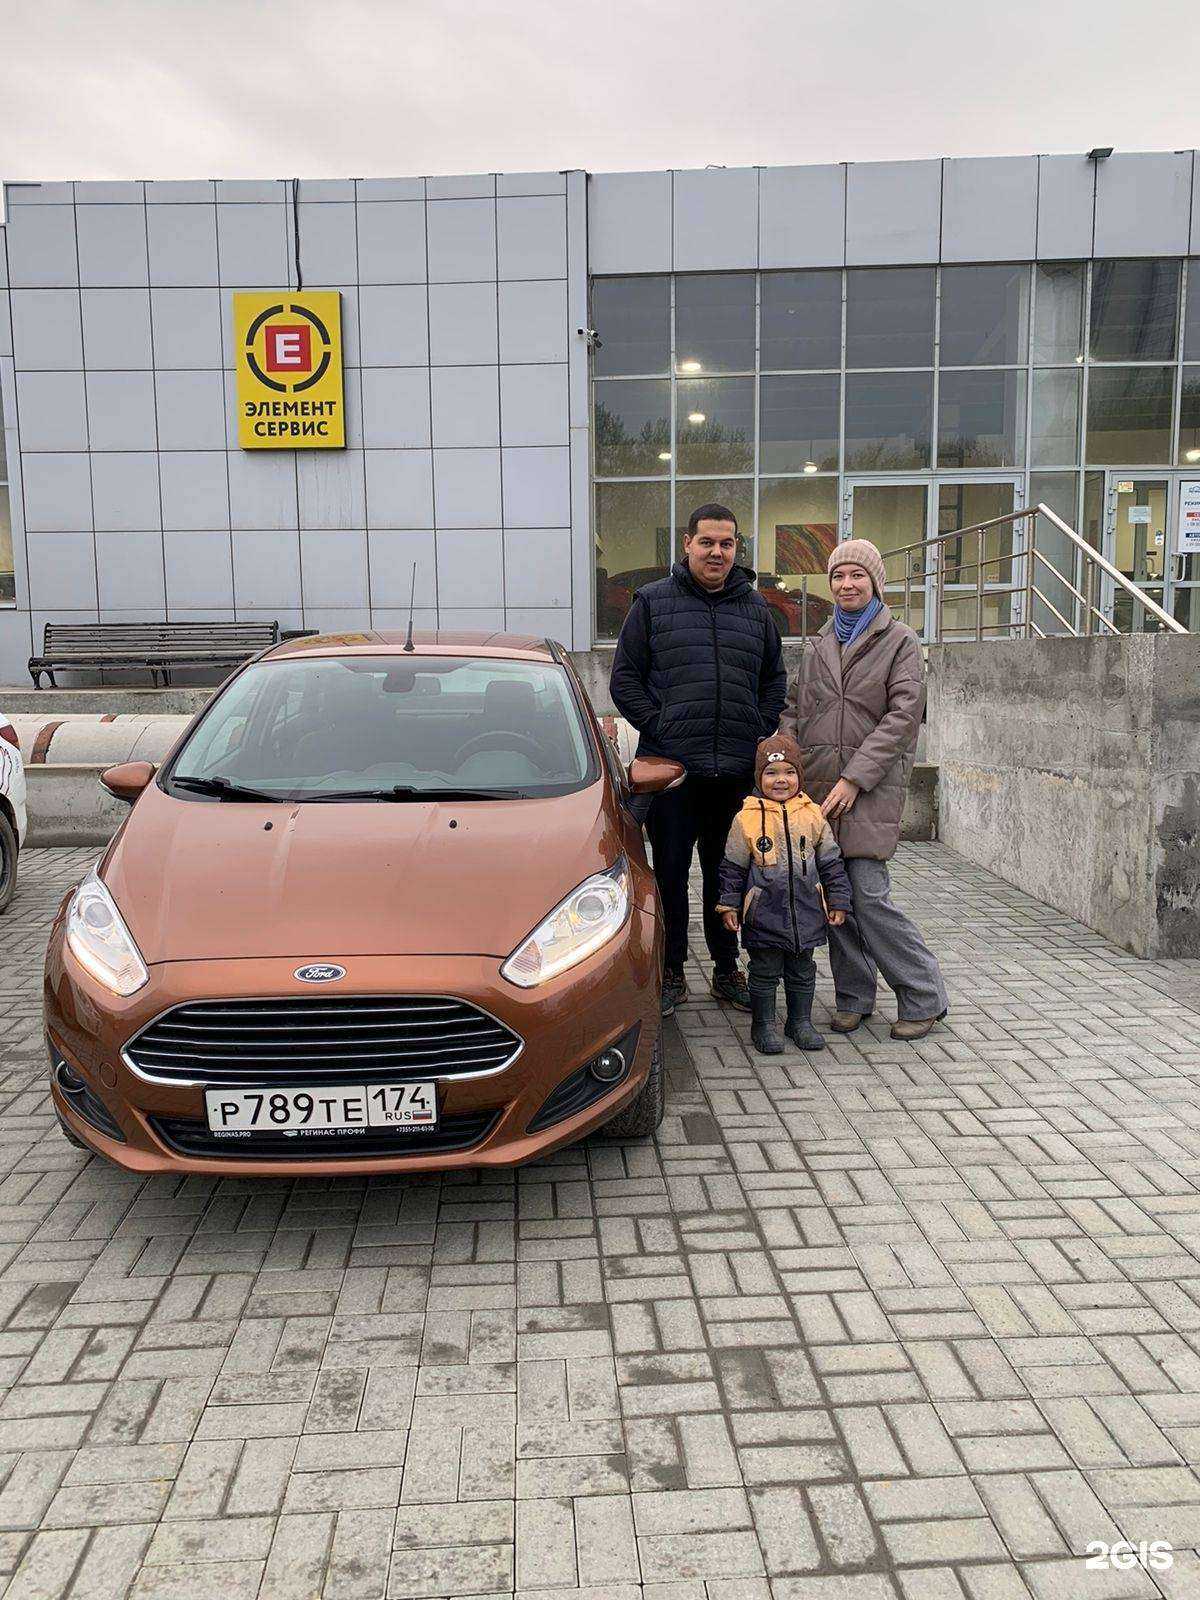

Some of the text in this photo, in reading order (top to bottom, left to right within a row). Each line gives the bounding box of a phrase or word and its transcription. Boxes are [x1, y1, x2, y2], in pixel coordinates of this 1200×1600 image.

[245, 401, 337, 417] ЭЛЕМЕНТ
[254, 421, 329, 437] СЕРВИС
[305, 966, 335, 978] Ford
[372, 1086, 426, 1112] 174
[385, 1111, 412, 1121] RUS
